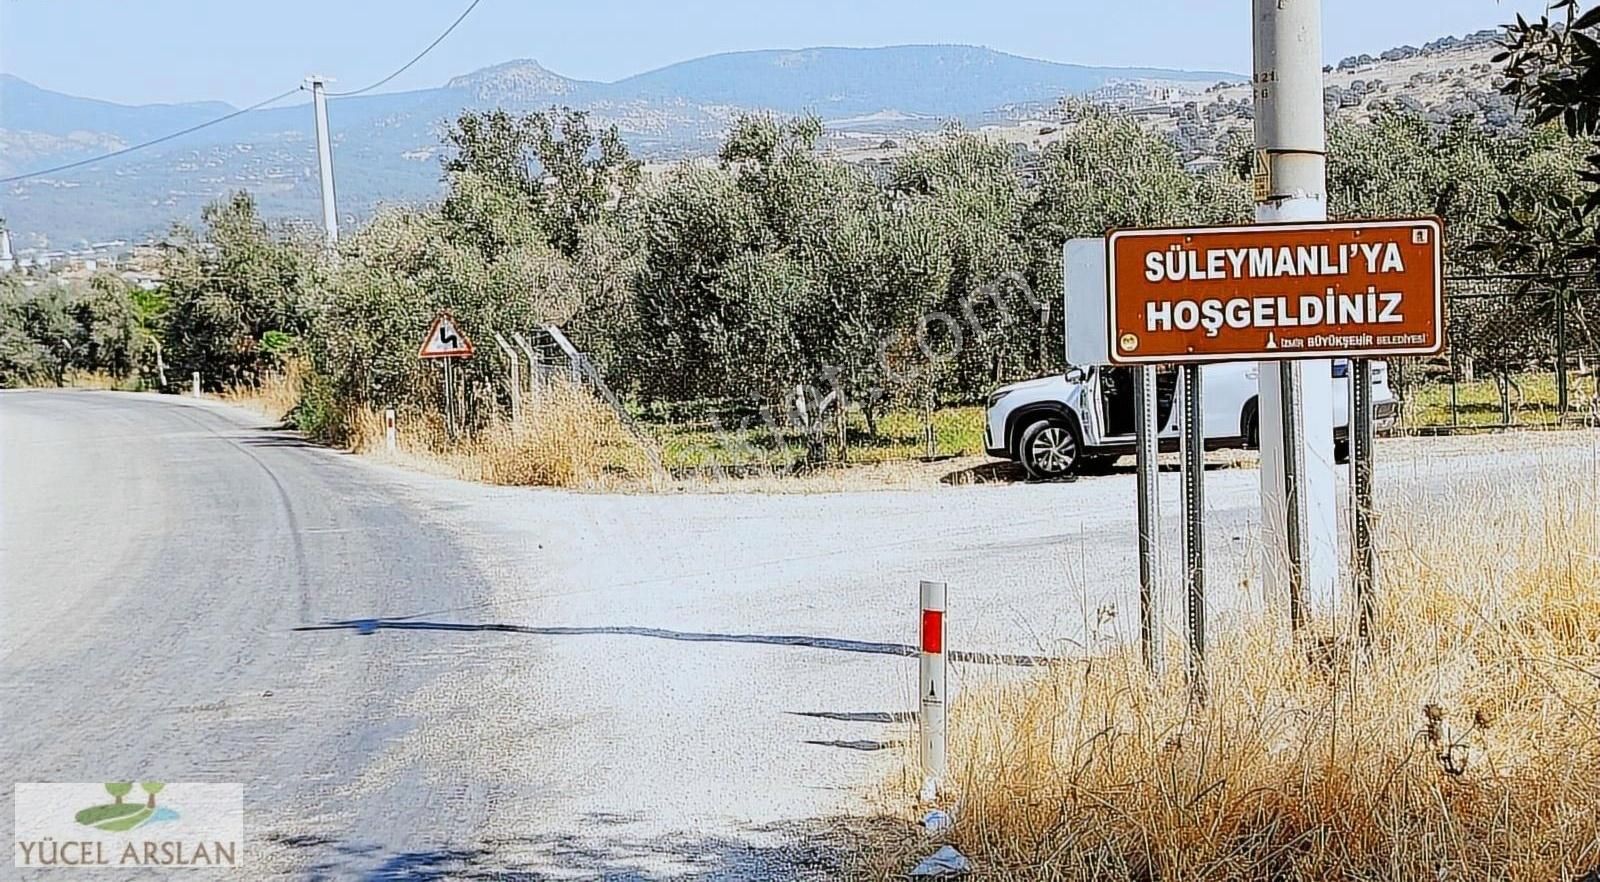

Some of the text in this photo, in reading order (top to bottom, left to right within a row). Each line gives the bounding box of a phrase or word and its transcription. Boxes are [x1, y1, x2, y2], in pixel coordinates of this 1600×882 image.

[1145, 243, 1404, 282] SÜLEYMANLI'YA
[1146, 286, 1403, 337] HOŞGELDİNİZ
[1280, 333, 1426, 348] İZMİR BÜYÜKŞEHİR BELEDİYESİ
